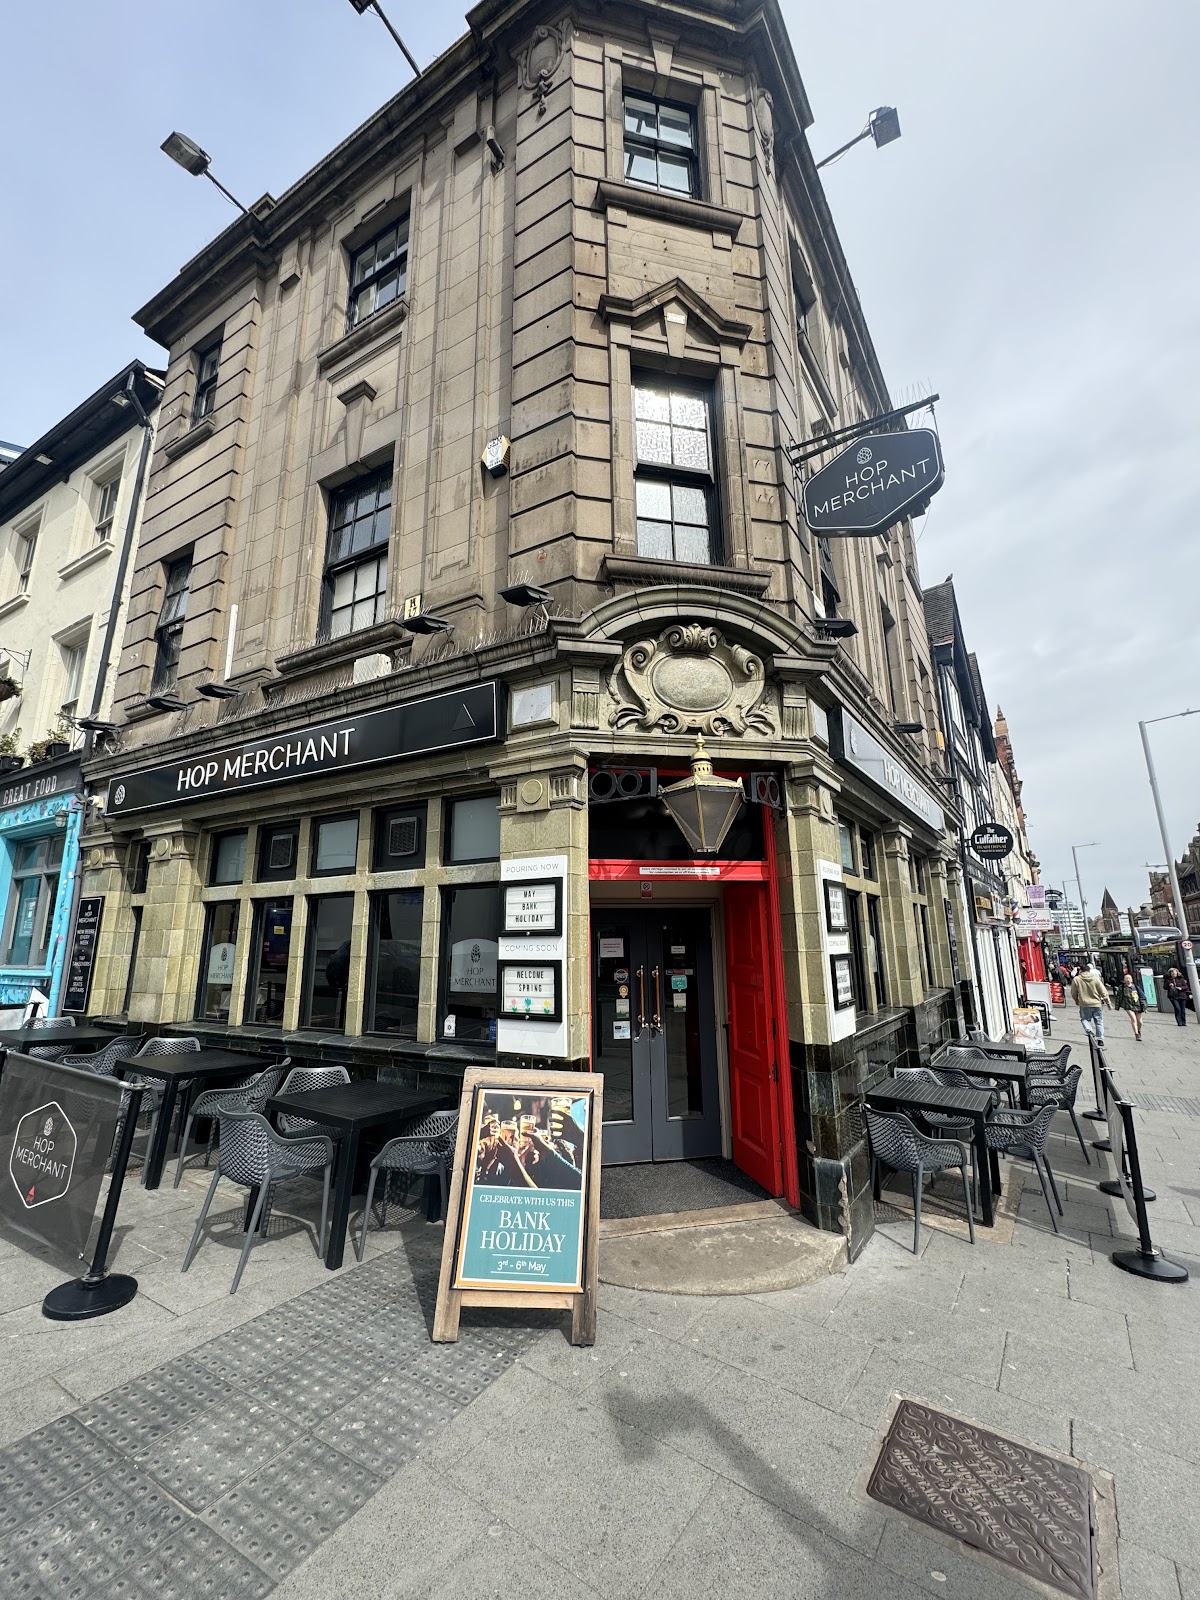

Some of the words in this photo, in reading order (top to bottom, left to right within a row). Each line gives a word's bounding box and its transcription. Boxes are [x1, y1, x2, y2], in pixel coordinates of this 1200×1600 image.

[845, 460, 888, 489] HOP
[813, 458, 930, 518] MERCHANT
[177, 762, 218, 791] HOP
[223, 728, 356, 781] MERCHANT
[883, 759, 900, 789] HOP
[3, 783, 31, 805] GREAT
[34, 775, 57, 797] FOOD
[986, 826, 995, 834] The
[506, 864, 538, 874] POURING
[540, 862, 559, 872] NOW
[523, 890, 536, 898] MAY
[522, 902, 537, 911] BANK
[515, 915, 544, 923] HOLIDAY
[505, 944, 534, 952] COMING
[536, 943, 558, 952] SOON
[467, 967, 484, 976] HOP
[516, 970, 544, 979] WELCOME
[455, 978, 496, 987] MERCHANT
[518, 984, 542, 993] SPRING
[33, 1136, 55, 1155] HOP
[15, 1146, 68, 1180] MERCHANT
[480, 1194, 523, 1205] CELEBRATE
[524, 1196, 545, 1206] WITH
[546, 1197, 556, 1207] US
[556, 1198, 575, 1208] THIS
[499, 1210, 551, 1231] BANK
[480, 1230, 567, 1253] HOLIDAY
[497, 1260, 509, 1271] 3rd
[515, 1260, 527, 1271] 6th
[528, 1261, 547, 1274] May
[892, 1448, 946, 1505] CHIEFTAIN
[940, 1508, 968, 1534] 600
[908, 1431, 954, 1476] STANTON
[958, 1486, 1020, 1549] STAVELEY
[949, 1460, 1001, 1509] DUCTILE
[965, 1459, 1018, 1507] DUCTILE
[1012, 1487, 1073, 1545] STANTON
